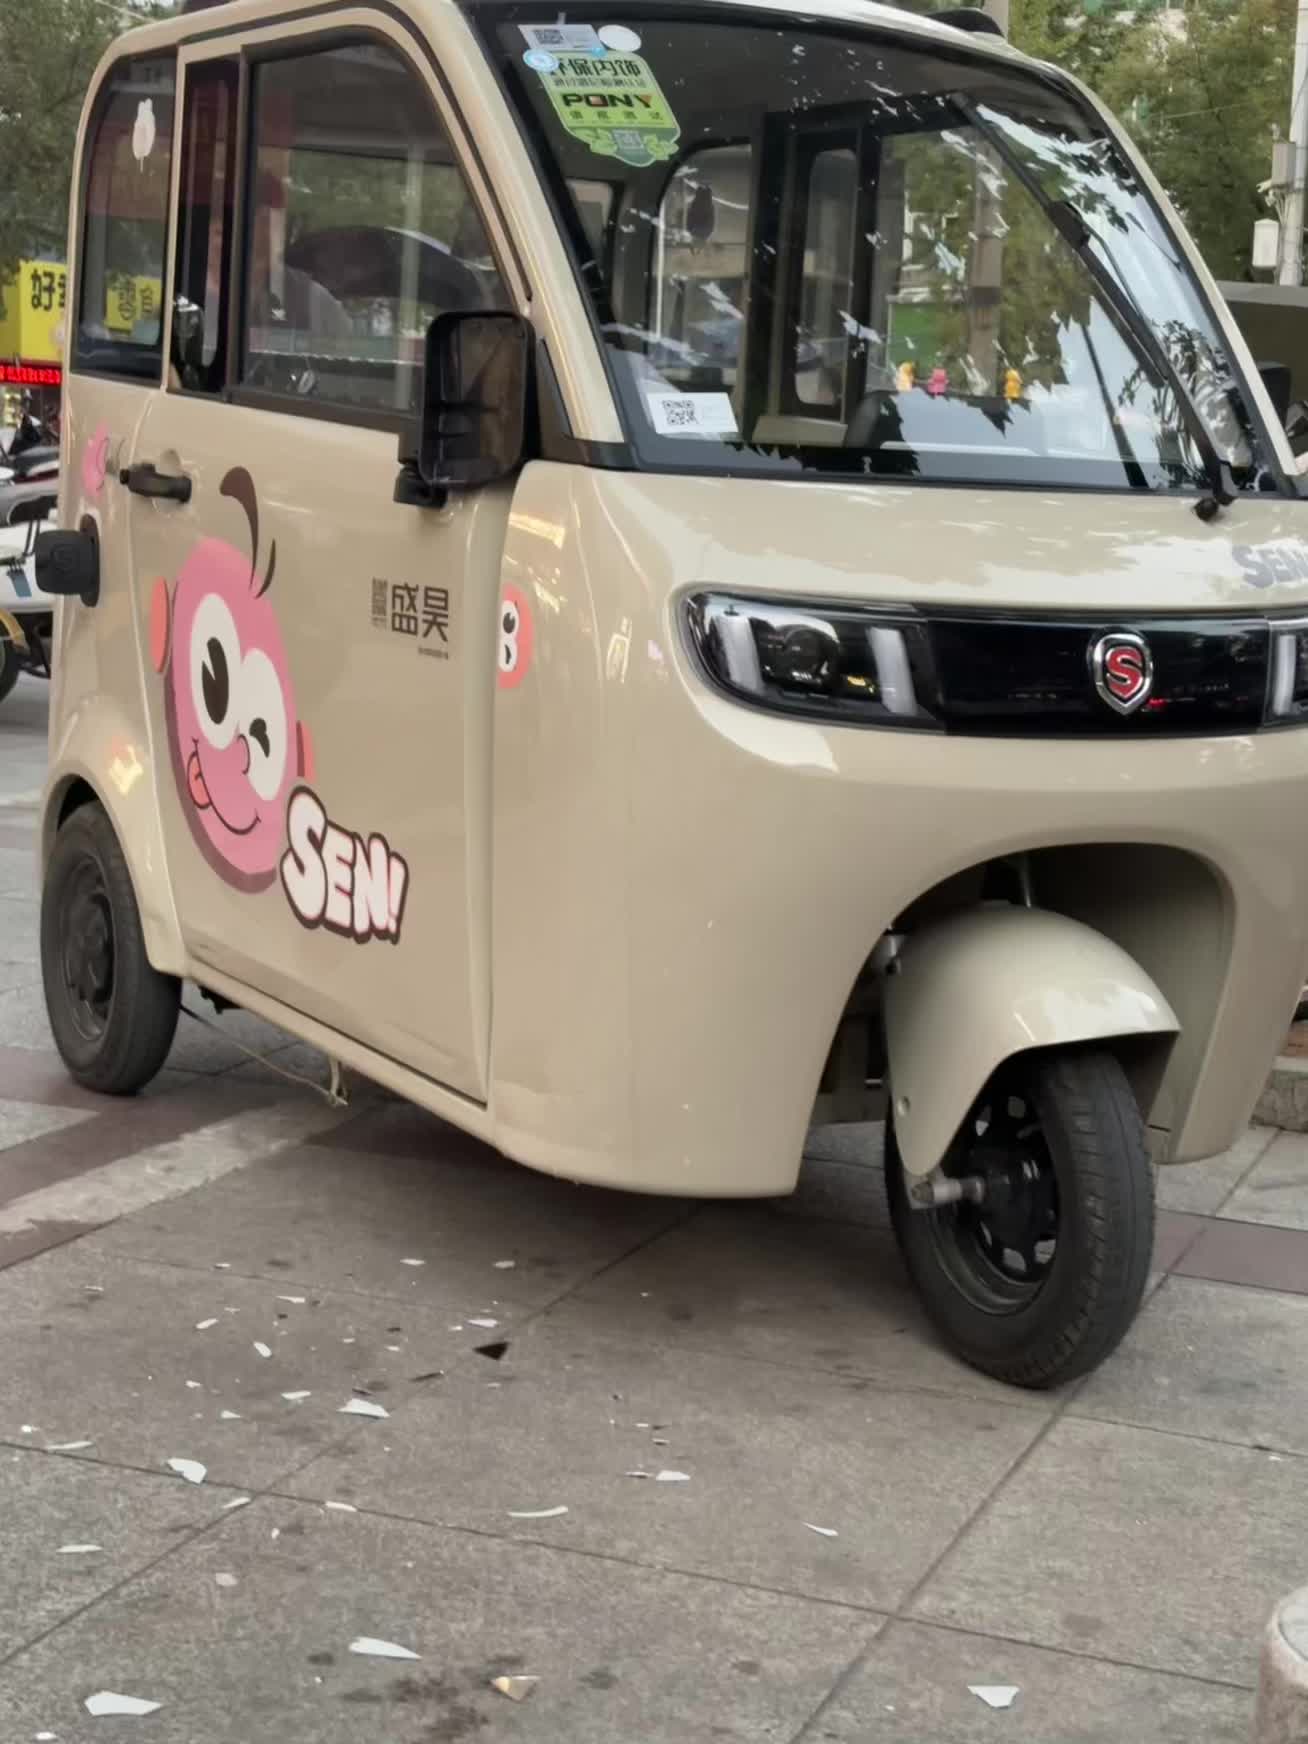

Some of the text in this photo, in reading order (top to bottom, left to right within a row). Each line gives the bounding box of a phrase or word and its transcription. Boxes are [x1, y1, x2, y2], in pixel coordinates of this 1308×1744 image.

[561, 93, 653, 109] PONY
[391, 582, 449, 642] 盛昊
[1105, 645, 1145, 699] S
[280, 785, 410, 946] SEN!
